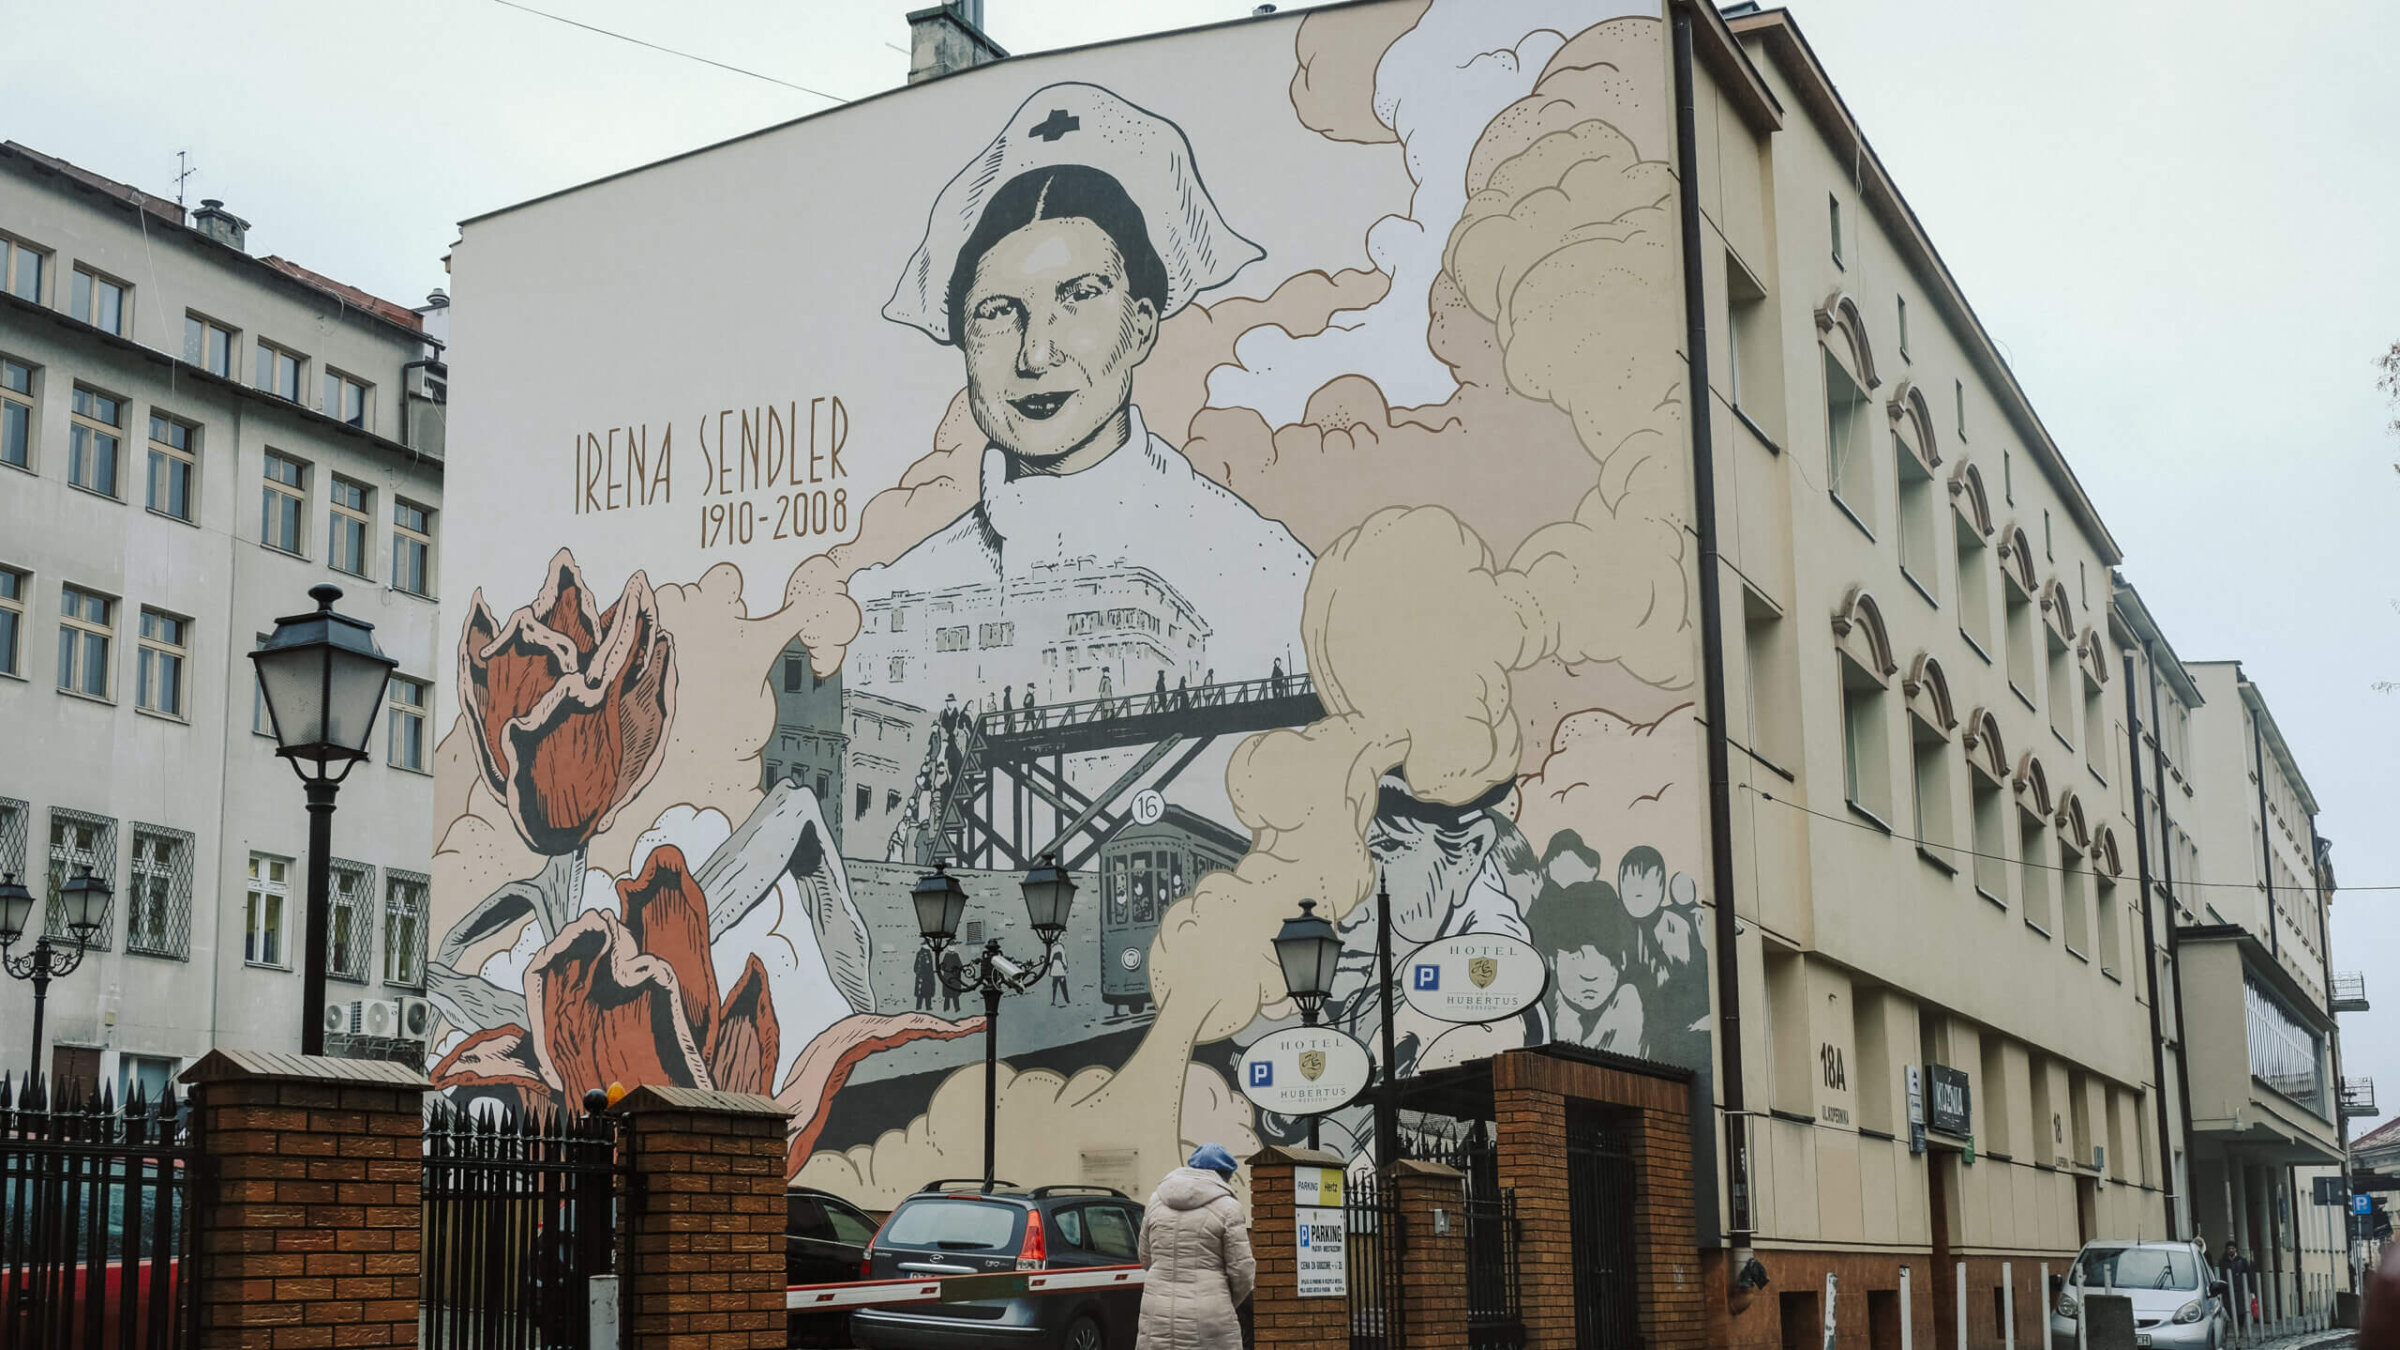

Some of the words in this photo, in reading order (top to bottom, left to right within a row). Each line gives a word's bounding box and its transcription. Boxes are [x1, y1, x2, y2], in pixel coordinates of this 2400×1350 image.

[575, 421, 672, 516] IRENA
[699, 395, 849, 496] SENDLER
[701, 487, 848, 549] 1910-2008
[1138, 795, 1159, 821] 16
[1449, 945, 1518, 956] HOTEL
[1419, 967, 1434, 987] P
[1446, 996, 1519, 1006] HUBERTUS
[1280, 1038, 1344, 1051] HOTEL
[1254, 1064, 1268, 1084] P
[1820, 1041, 1847, 1092] 18A
[1280, 1087, 1347, 1099] HUBERTUS
[1298, 1180, 1318, 1192] PARKING
[1324, 1181, 1338, 1193] Hertz
[2355, 1196, 2368, 1211] P
[1311, 1224, 1342, 1243] PARKING
